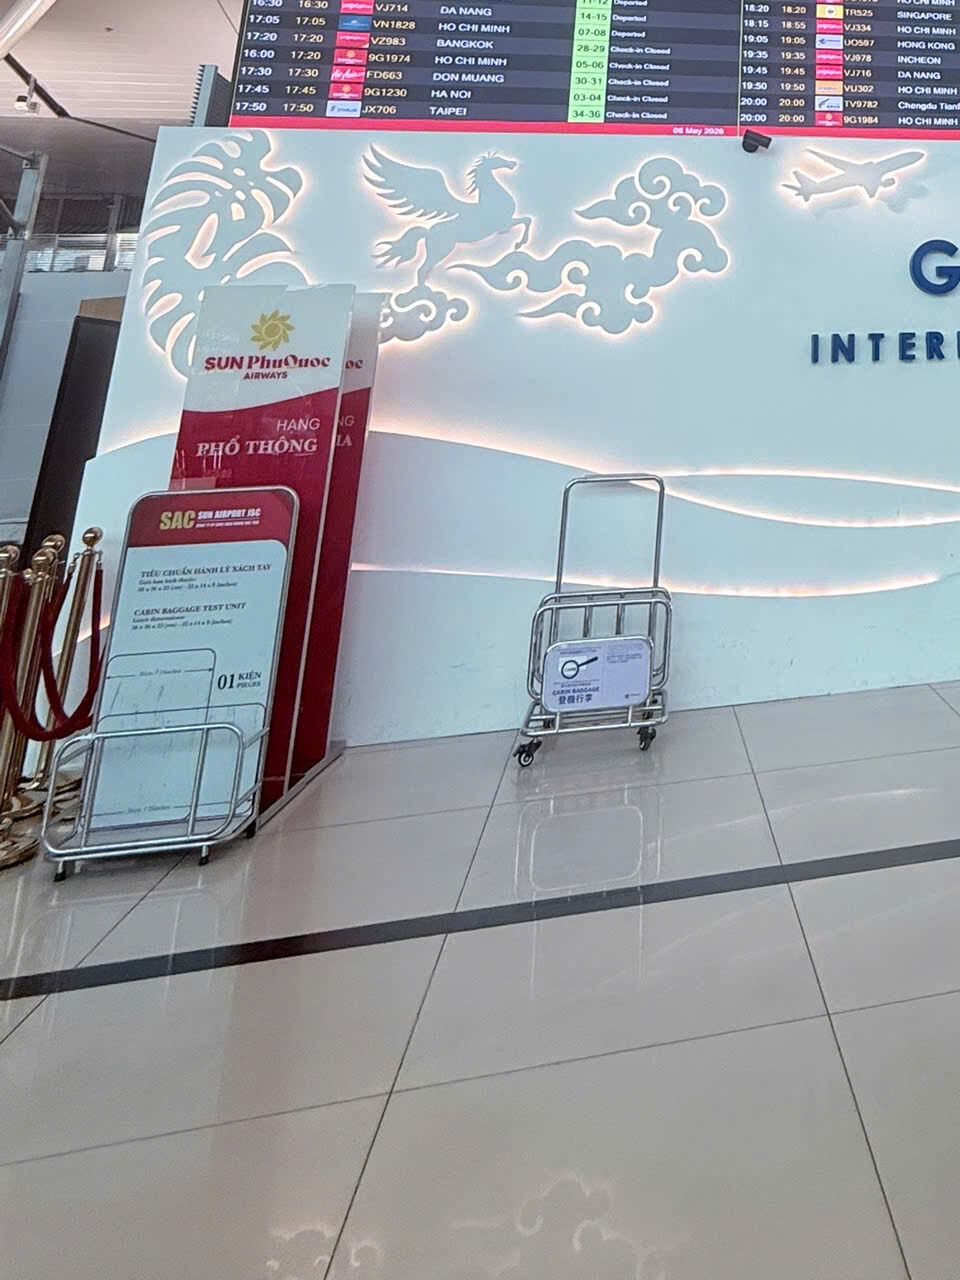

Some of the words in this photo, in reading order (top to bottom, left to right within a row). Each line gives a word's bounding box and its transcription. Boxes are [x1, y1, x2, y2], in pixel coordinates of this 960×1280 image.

[299, 0, 328, 8] 16:30
[375, 4, 408, 12] VJ714
[440, 6, 456, 14] DA
[459, 7, 492, 16] NANG
[581, 12, 607, 20] 14-15
[745, 4, 769, 12] 18:20
[897, 11, 952, 20] SINGAPORE
[249, 15, 280, 24] 17:05
[296, 17, 326, 25] 17:05
[373, 20, 415, 29] VN1828
[439, 23, 456, 31] HO
[458, 23, 478, 32] CHI
[480, 24, 510, 33] MINH
[744, 20, 769, 28] 18:15
[914, 26, 930, 34] CHI
[932, 27, 956, 35] MINH
[247, 32, 277, 41] 17:20
[294, 34, 323, 42] 17:20
[370, 37, 406, 46] VZ983
[436, 39, 494, 49] BANGKOK
[744, 35, 768, 43] 19:05
[898, 41, 925, 49] HONG
[928, 42, 955, 50] KONG
[244, 49, 275, 58] 16:00
[291, 51, 321, 60] 17:20
[368, 54, 410, 63] 9G1974
[434, 56, 452, 64] HO
[455, 56, 475, 65] CHI
[478, 58, 507, 66] MINH
[898, 56, 941, 64] INCHEON
[241, 67, 272, 76] 17:30
[288, 68, 318, 77] 17:30
[366, 71, 402, 80] FD663
[433, 73, 459, 81] DON
[461, 74, 504, 83] MUANG
[743, 66, 768, 74] 19:45
[238, 84, 269, 93] 17:45
[286, 86, 316, 94] 17:45
[364, 88, 407, 97] 9G1230
[431, 90, 447, 98] HA
[450, 90, 471, 98] NOI
[742, 82, 767, 90] 19:50
[898, 86, 912, 94] HO
[933, 87, 957, 95] MINH
[235, 102, 267, 111] 17:50
[283, 104, 313, 112] 17:50
[362, 106, 396, 114] JX706
[429, 106, 467, 115] TAIPEI
[741, 98, 767, 106] 20:00
[741, 114, 767, 122] 20:00
[899, 117, 913, 125] HO
[934, 118, 958, 126] MINH
[204, 356, 244, 370] SUN
[247, 354, 331, 370] PhuQuoc
[243, 372, 288, 380] AIRWAYS
[196, 435, 240, 456] PHỔ
[246, 438, 318, 456] THÔNG
[160, 510, 196, 530] SAC
[214, 509, 246, 519] AIRPORT
[134, 608, 160, 616] CABIN
[162, 606, 201, 614] BAGGAGE
[203, 604, 224, 612] TEST
[225, 602, 246, 610] UNIT
[218, 673, 234, 690] 01
